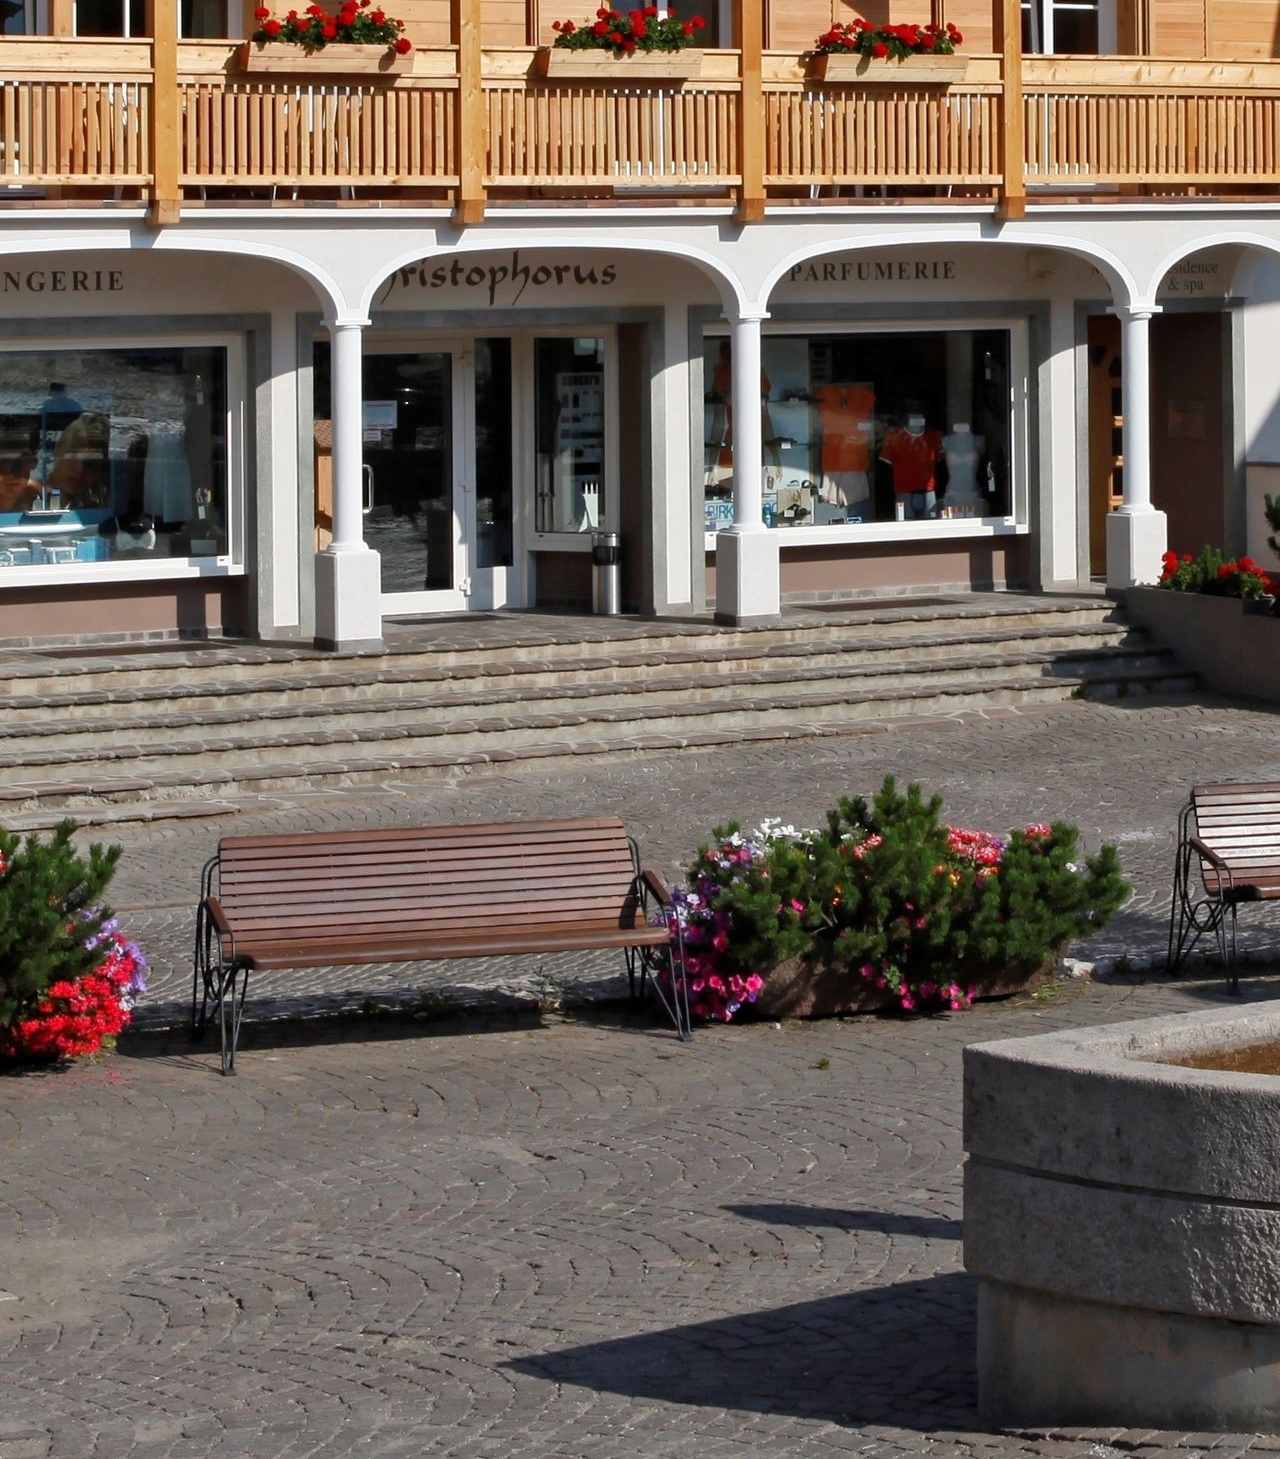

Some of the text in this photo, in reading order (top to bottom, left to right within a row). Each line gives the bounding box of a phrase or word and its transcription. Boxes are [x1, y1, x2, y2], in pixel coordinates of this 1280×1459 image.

[381, 250, 617, 307] ristophorus
[790, 261, 957, 281] PARFUMERIE
[1168, 277, 1204, 294] & spa
